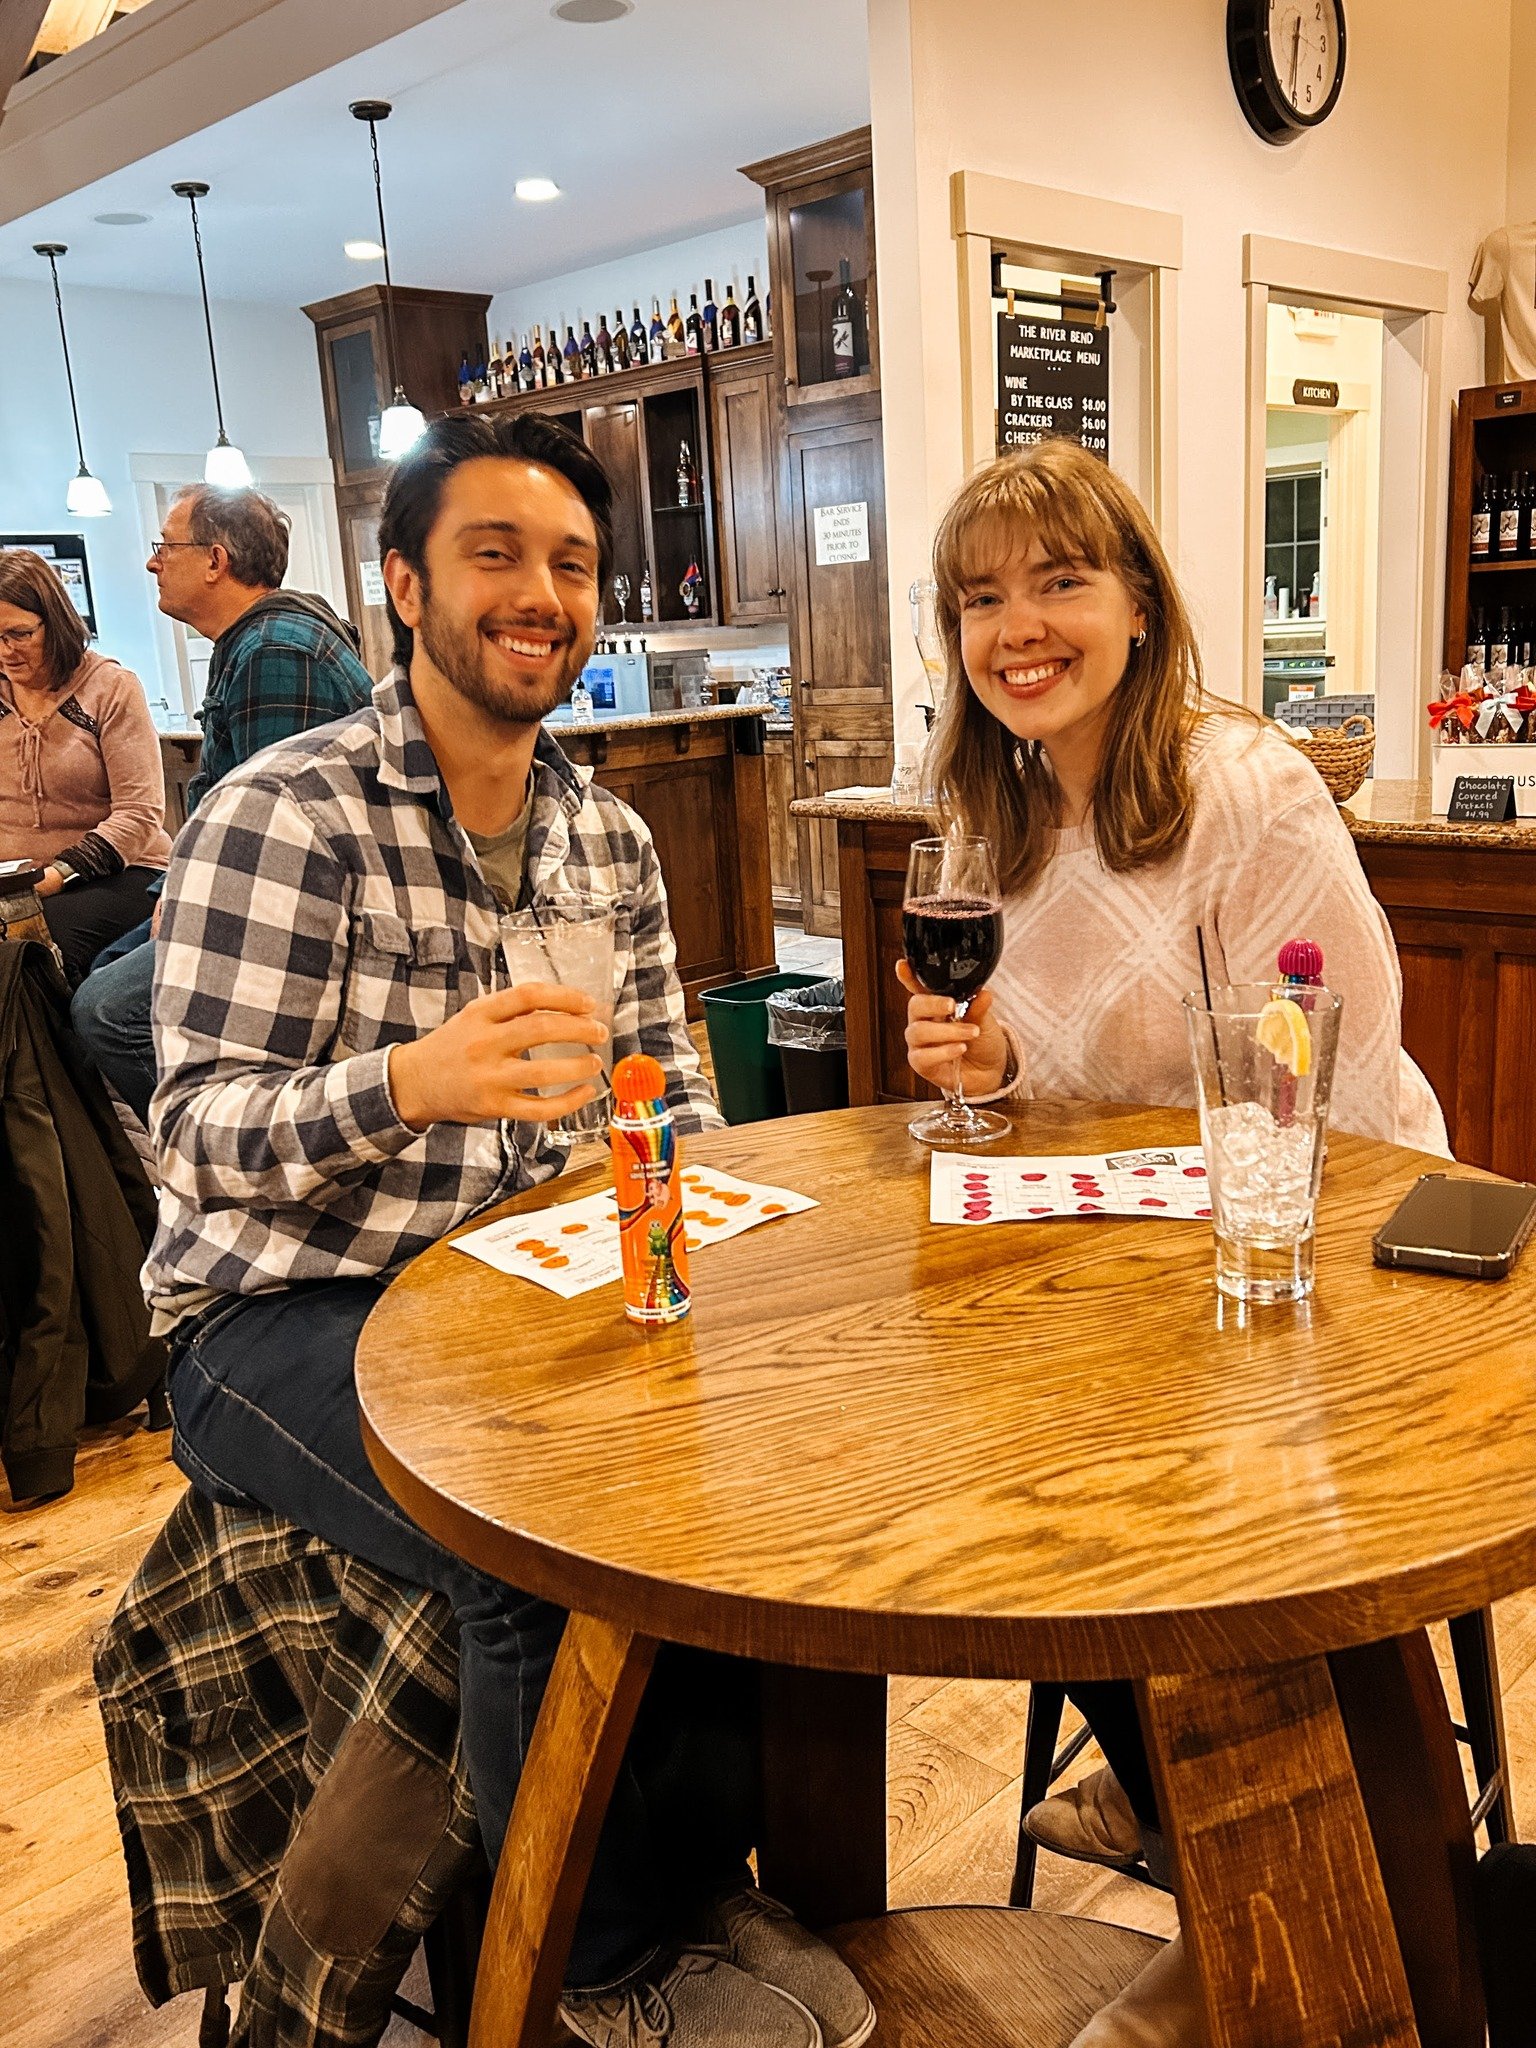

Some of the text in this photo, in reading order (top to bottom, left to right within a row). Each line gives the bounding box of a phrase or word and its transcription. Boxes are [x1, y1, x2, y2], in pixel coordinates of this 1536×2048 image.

[1315, 2, 1321, 20] 2
[1320, 34, 1326, 53] 3
[1316, 64, 1321, 82] 4
[1306, 84, 1311, 103] 5
[1019, 324, 1094, 345] THE RIVER BEND
[1010, 344, 1101, 366] MARKETPLACE MENU
[1004, 375, 1028, 389] WINE
[1303, 386, 1331, 399] KITCHEN
[1010, 394, 1106, 412] BY THE GLASS $8.00
[1004, 412, 1106, 430] CRACKERS $6.00
[1081, 433, 1106, 449] $7.00
[833, 518, 850, 527] ENDS
[823, 529, 861, 540] 30 MINUTES
[826, 540, 859, 551] PRIOR TO
[829, 552, 857, 562] CLOSING
[1459, 780, 1507, 791] Chocolate
[1455, 801, 1494, 810] Pretzels
[1465, 811, 1490, 819] $4.99
